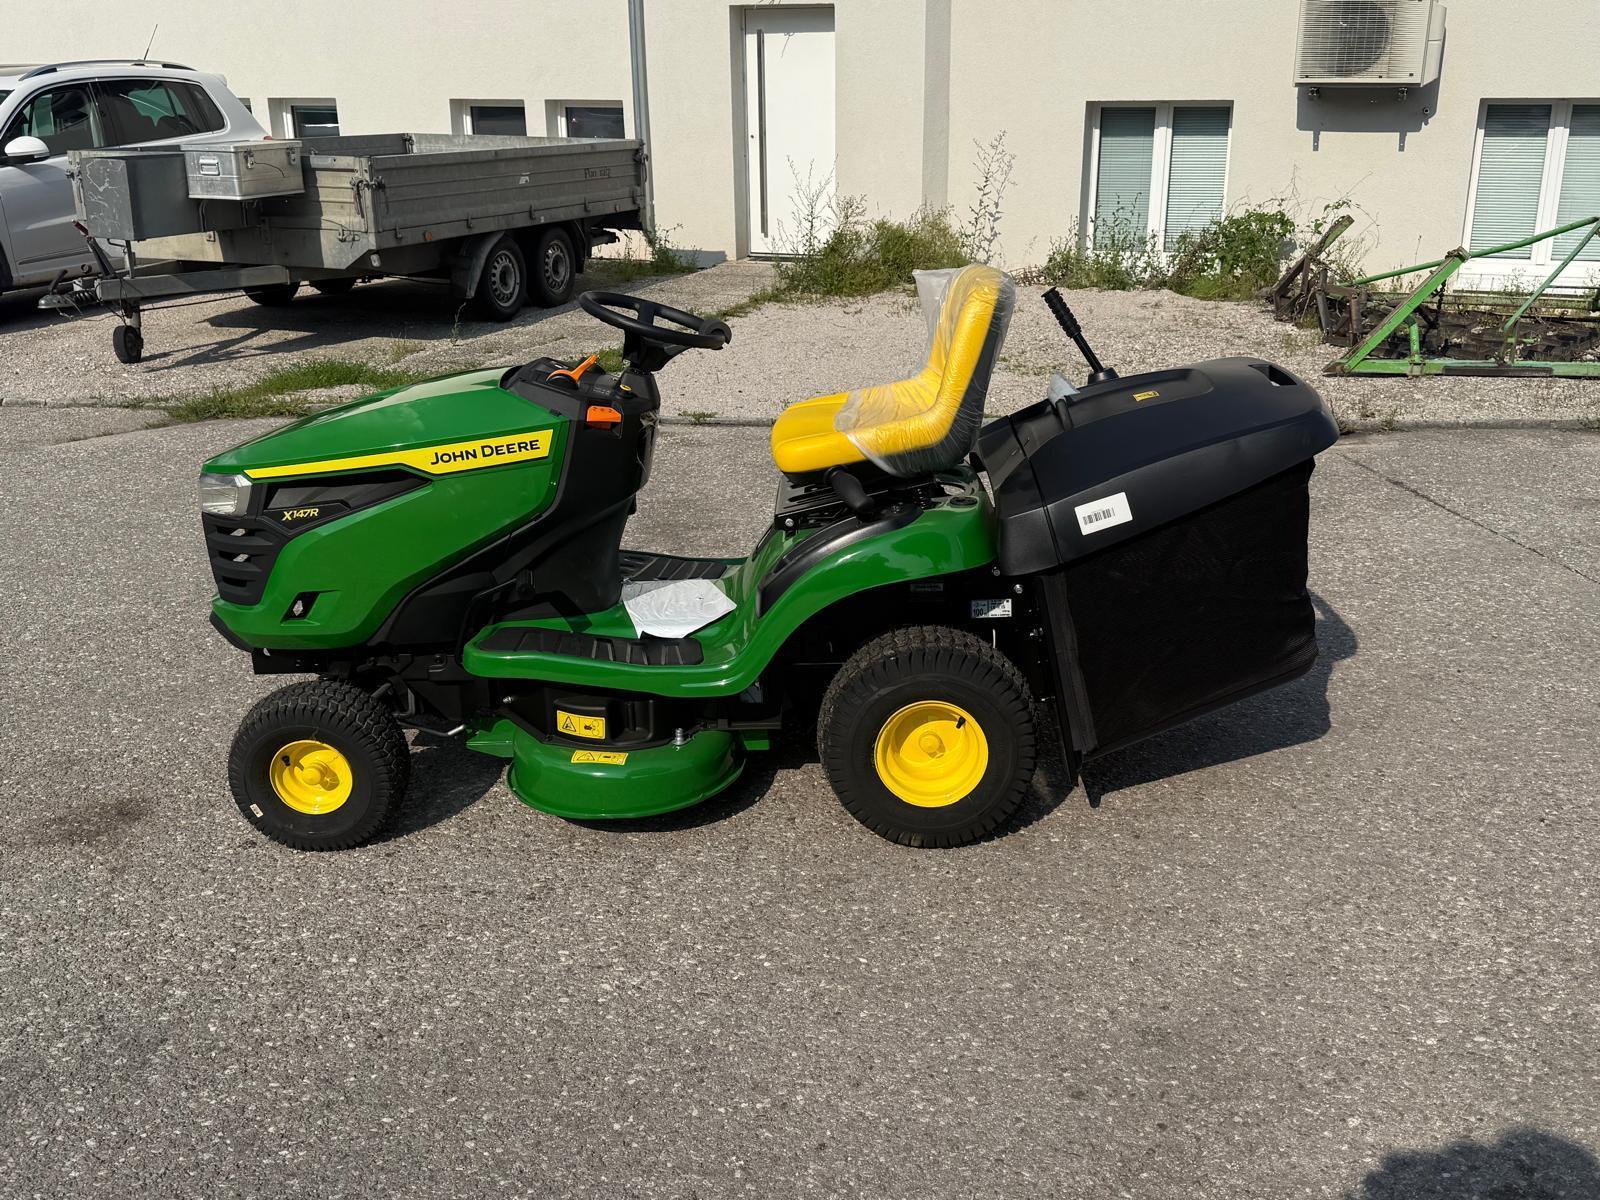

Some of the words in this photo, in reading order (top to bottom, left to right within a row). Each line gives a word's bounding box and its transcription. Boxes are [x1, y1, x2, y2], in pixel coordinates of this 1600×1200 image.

[430, 449, 478, 466] JOHN
[480, 439, 541, 458] DEERE
[281, 508, 320, 521] X147R
